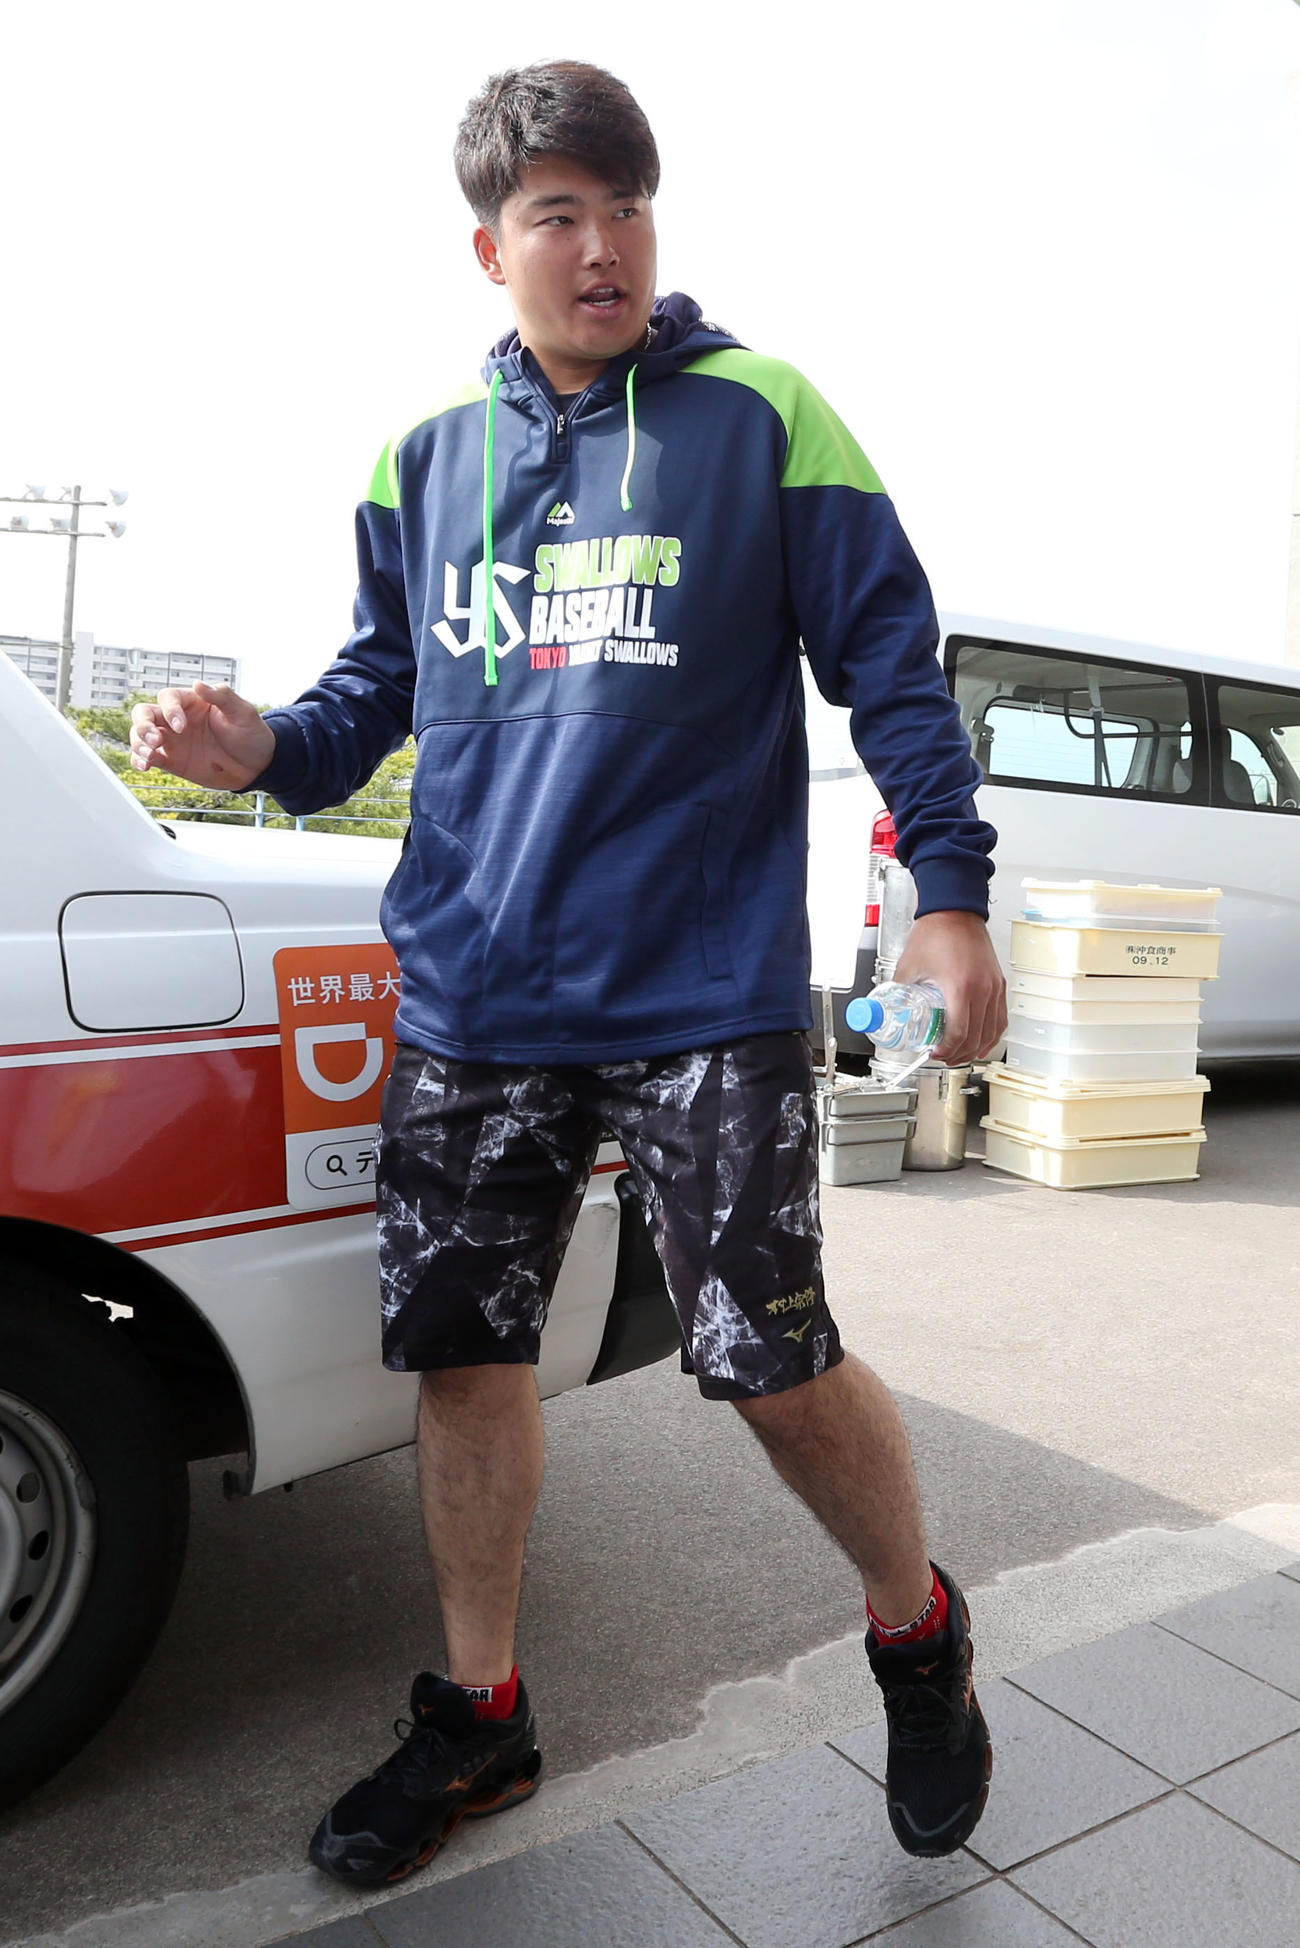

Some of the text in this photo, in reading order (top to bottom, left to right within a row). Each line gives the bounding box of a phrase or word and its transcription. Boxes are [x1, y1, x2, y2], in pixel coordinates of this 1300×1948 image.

[533, 535, 682, 593] SWALLOWS
[528, 587, 656, 645] BASEBALL
[528, 646, 568, 670] TOKYO
[603, 639, 679, 667] SWALLOWS
[287, 971, 401, 1007] 世界最大
